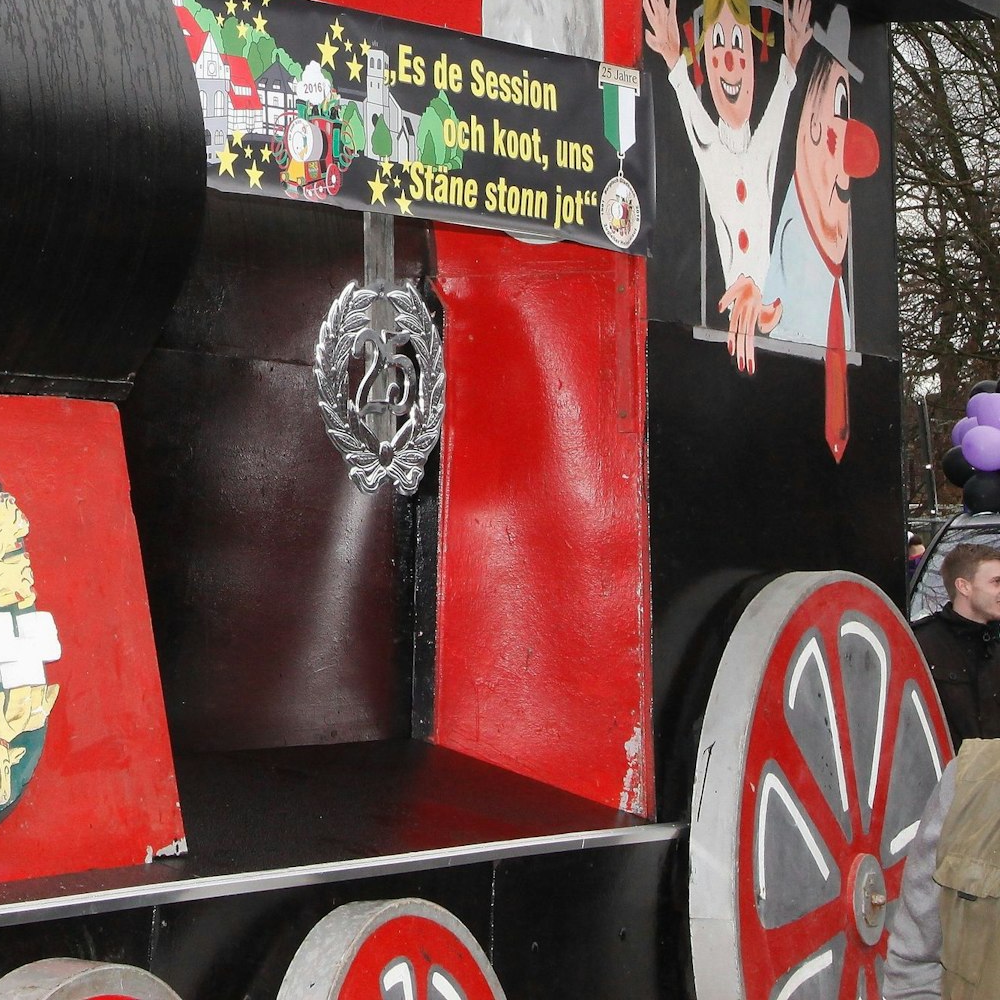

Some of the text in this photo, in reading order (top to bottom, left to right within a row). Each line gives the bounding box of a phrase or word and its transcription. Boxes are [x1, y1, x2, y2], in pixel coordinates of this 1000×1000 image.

[304, 83, 323, 94] 2016
[433, 53, 463, 93] de
[470, 59, 558, 111] Session
[601, 66, 638, 84] 25 Jahre
[443, 115, 595, 173] och koot, uns
[410, 161, 479, 208] Stäne
[485, 177, 548, 219] stonn
[352, 327, 416, 417] 25
